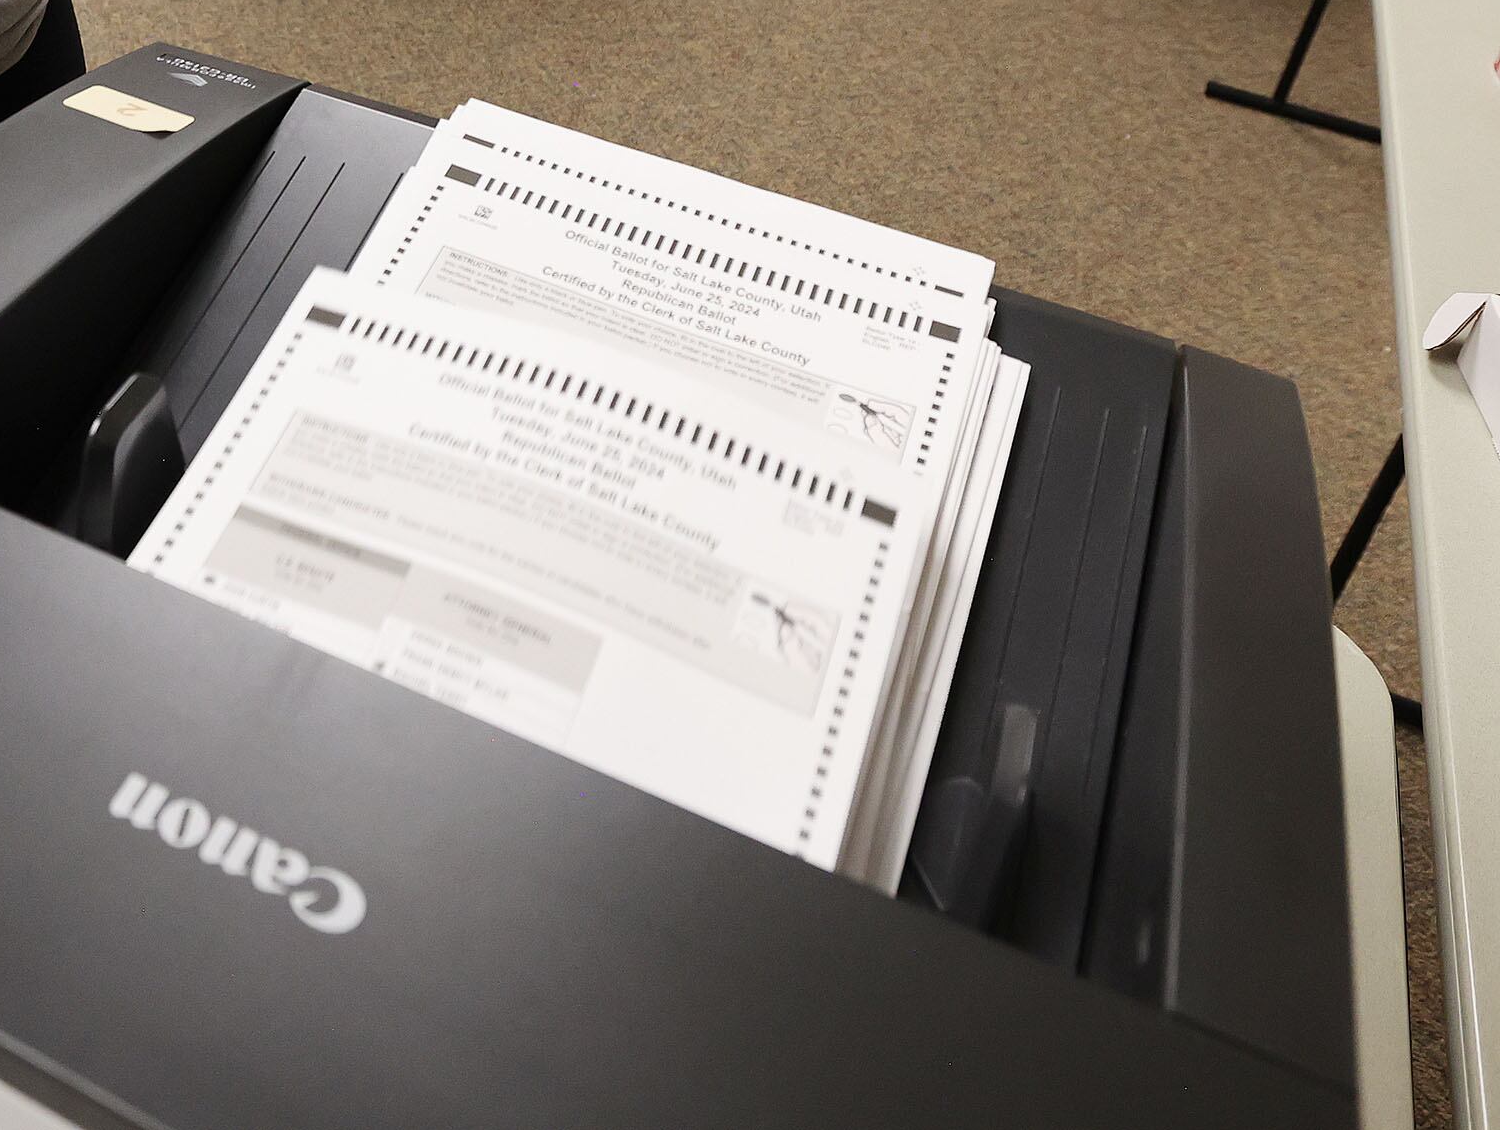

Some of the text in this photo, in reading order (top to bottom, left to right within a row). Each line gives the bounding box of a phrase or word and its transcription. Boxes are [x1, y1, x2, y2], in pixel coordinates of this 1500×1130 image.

[117, 102, 147, 117] 2
[564, 229, 612, 253] Official
[611, 245, 650, 267] Ballot
[651, 259, 671, 273] for
[672, 266, 700, 283] Salt
[700, 275, 733, 295] Lake
[790, 304, 823, 324] Utah
[621, 278, 738, 327] Republican Ballot
[670, 282, 705, 301] June
[728, 300, 762, 318] 2024
[542, 265, 812, 369] Certified by the Clerk of Salt Lake County
[438, 373, 492, 398] Official
[492, 387, 537, 412] Ballot
[539, 401, 561, 419] for
[564, 409, 595, 432] Salt
[596, 422, 635, 448] Lake
[700, 464, 738, 491] Utah
[501, 430, 638, 491] Republican Ballot
[561, 431, 599, 454] June
[628, 455, 666, 481] 2024
[409, 424, 720, 553] Certified by the Clerk of Salt Lake County
[107, 770, 369, 935] Canon
